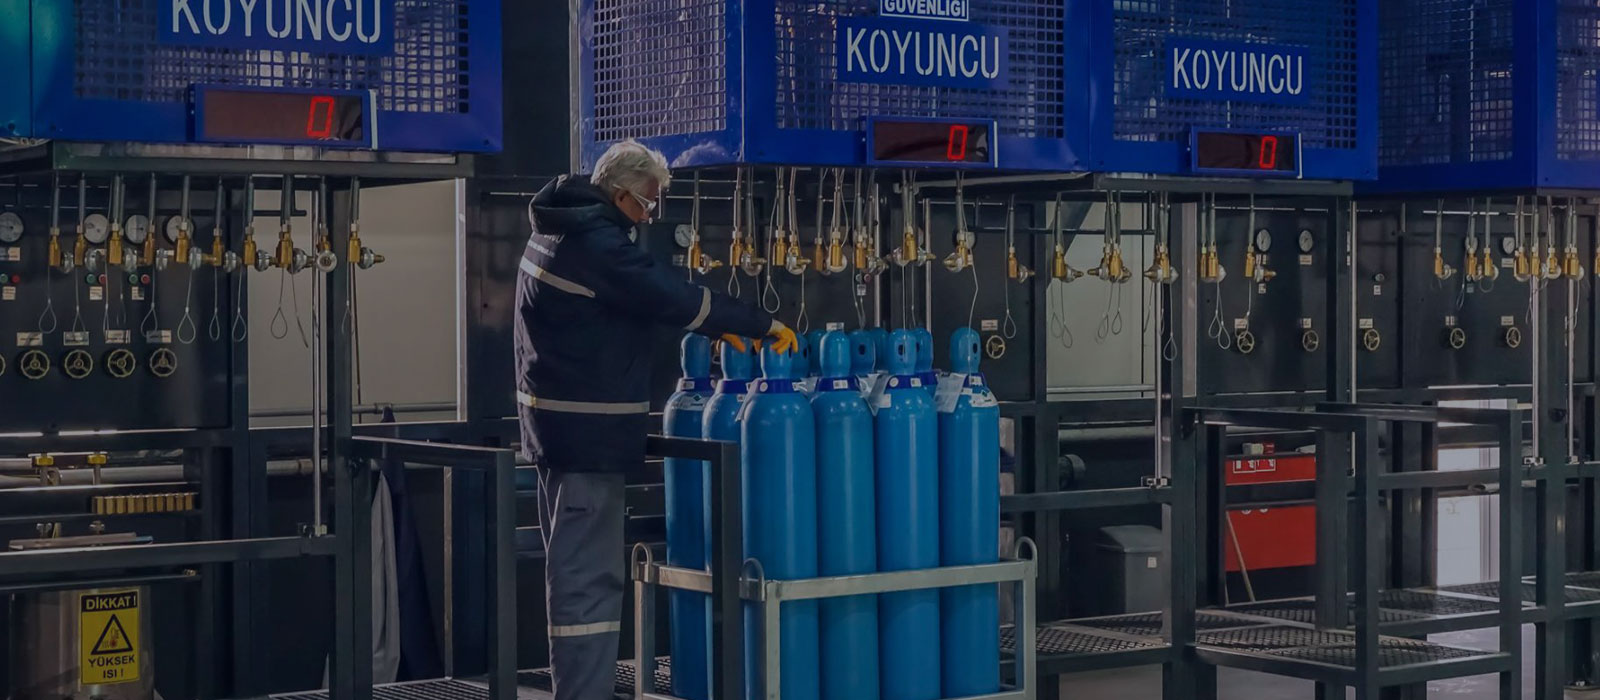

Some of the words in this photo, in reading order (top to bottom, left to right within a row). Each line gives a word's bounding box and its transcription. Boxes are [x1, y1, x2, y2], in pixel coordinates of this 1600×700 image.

[172, 0, 381, 43] KOYUNCU
[846, 27, 999, 79] KOYUNCU
[1173, 47, 1303, 95] KOYUNCU
[306, 95, 335, 137] 0
[947, 124, 968, 161] 0
[1259, 135, 1277, 169] 0
[88, 655, 135, 667] YÜKSEK
[103, 669, 117, 678] ISI
